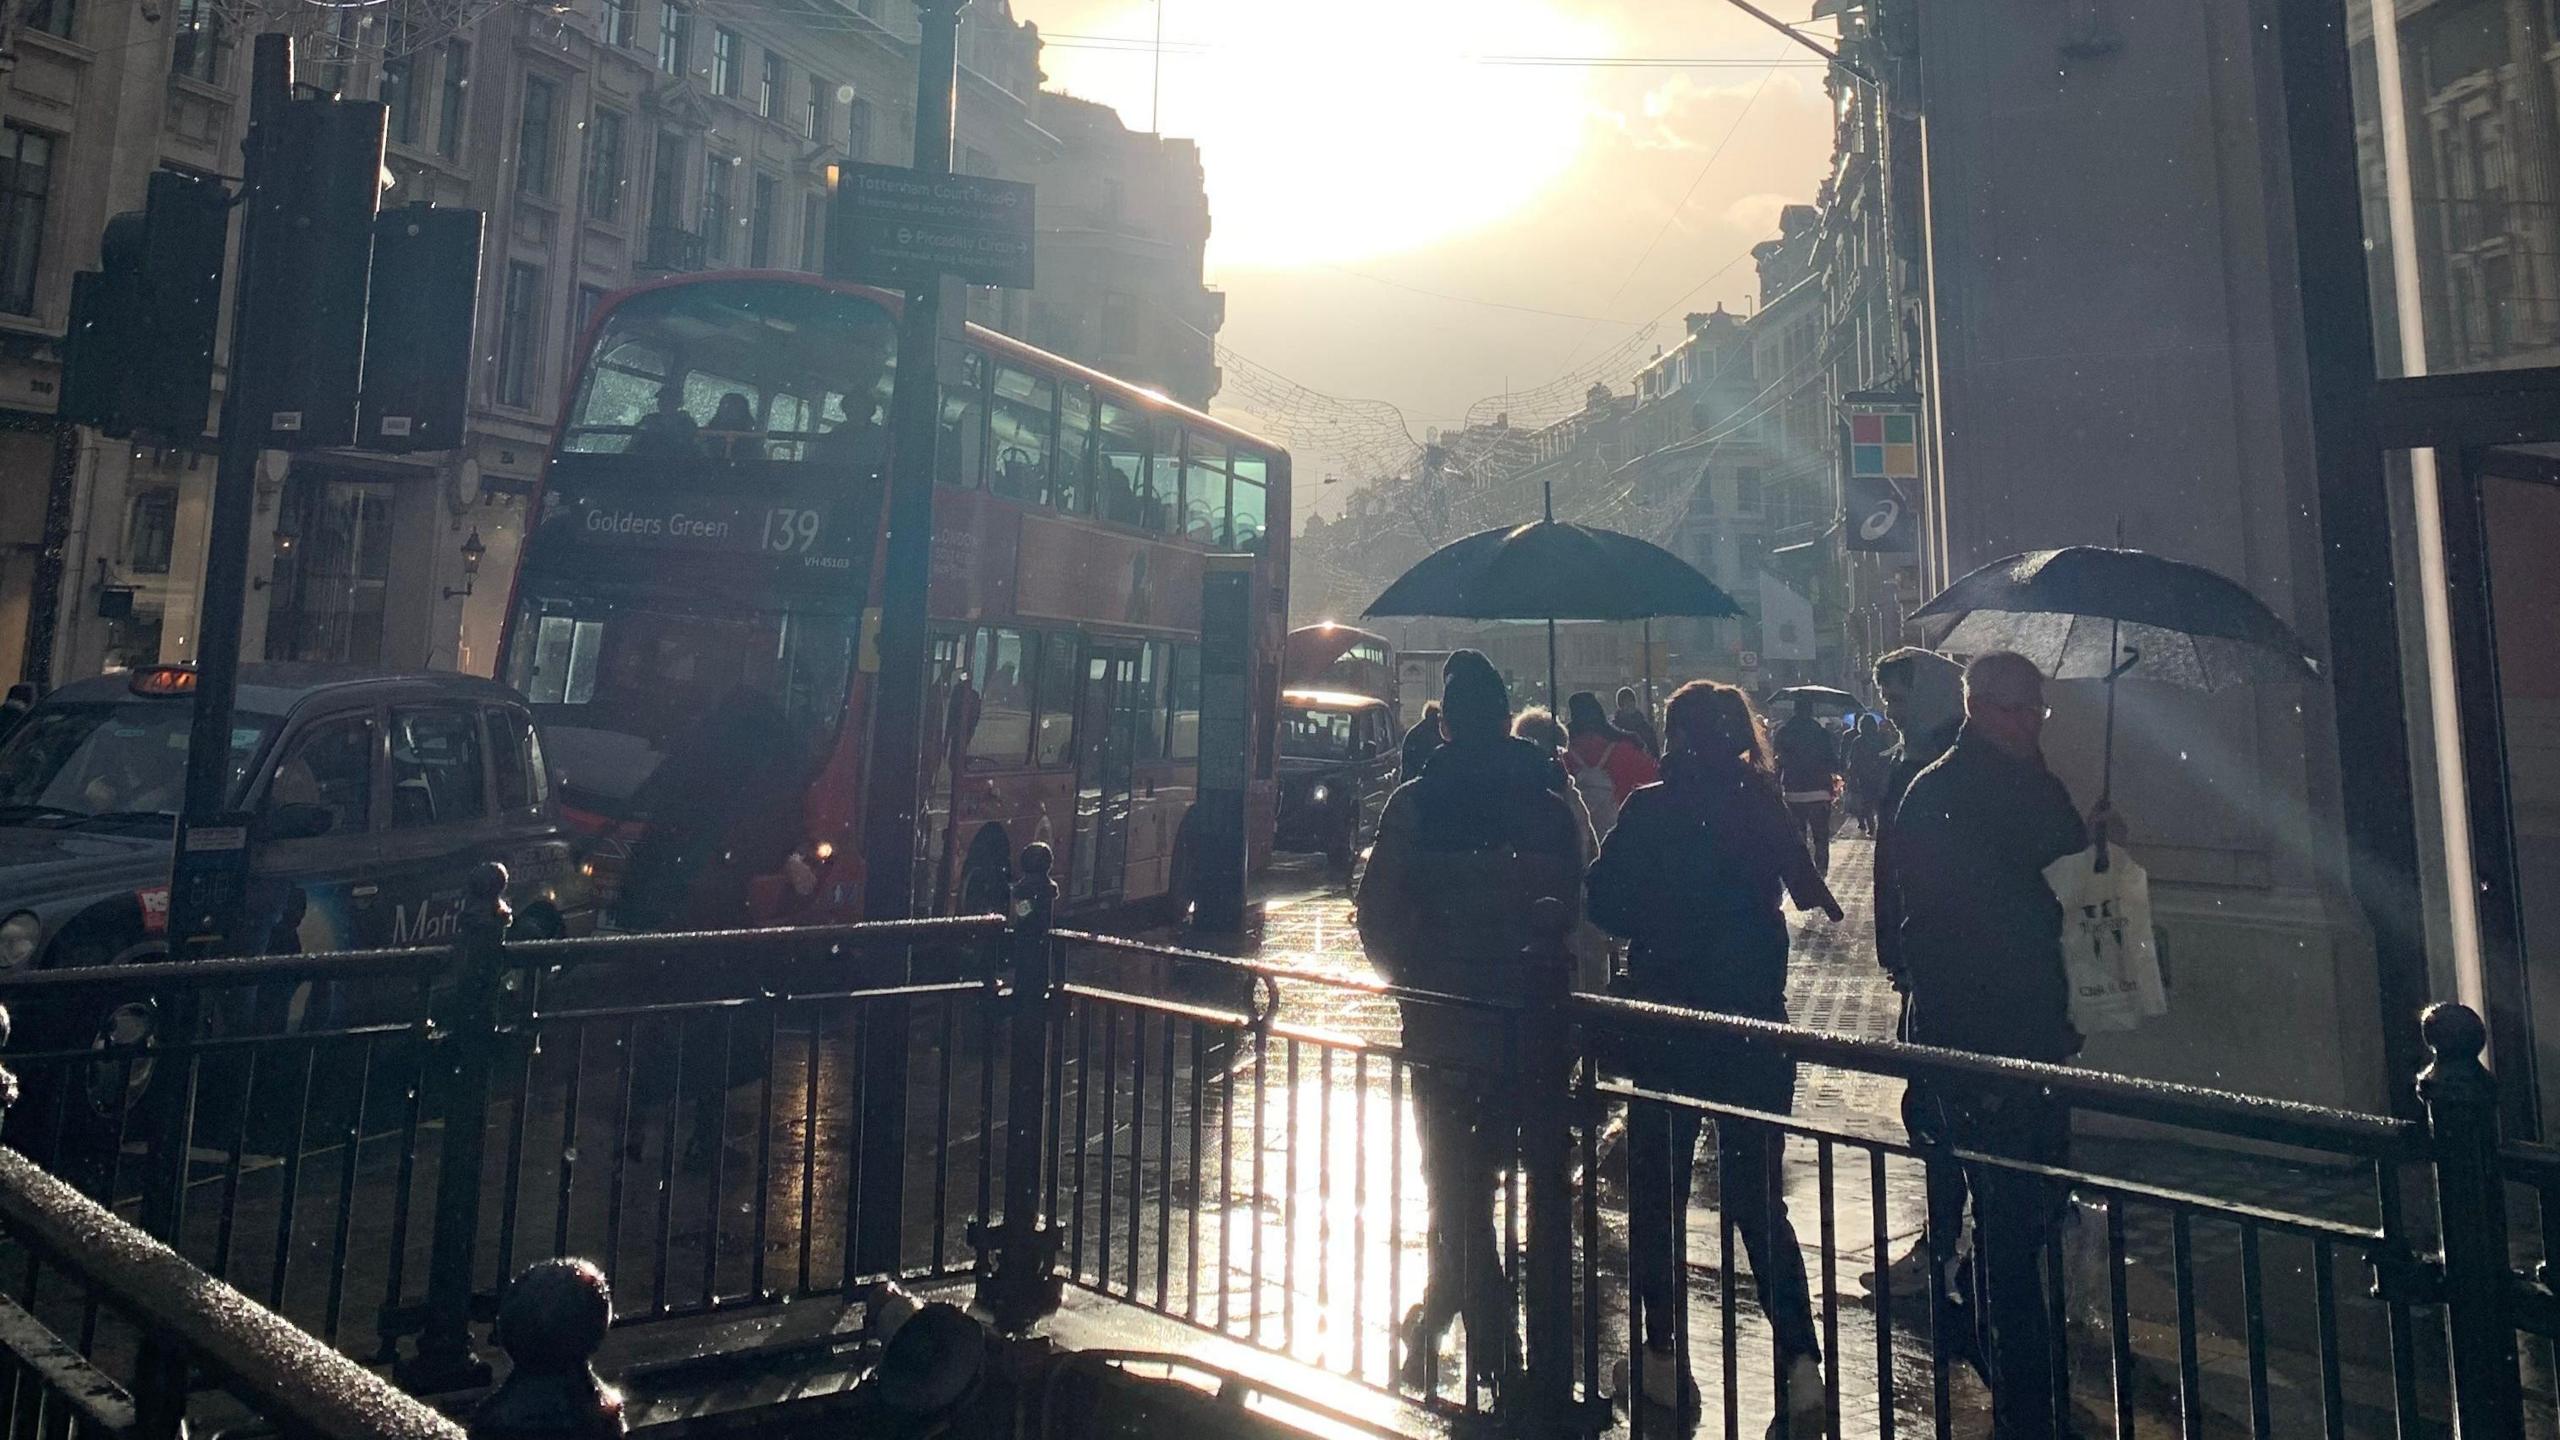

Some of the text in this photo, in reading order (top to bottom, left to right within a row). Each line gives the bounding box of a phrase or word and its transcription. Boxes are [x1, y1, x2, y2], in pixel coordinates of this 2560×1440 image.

[857, 174, 1004, 205] Tottenham Court Road
[916, 230, 1015, 254] Piccadilly Circus
[587, 509, 729, 538] Golders Green
[762, 508, 819, 552] 139
